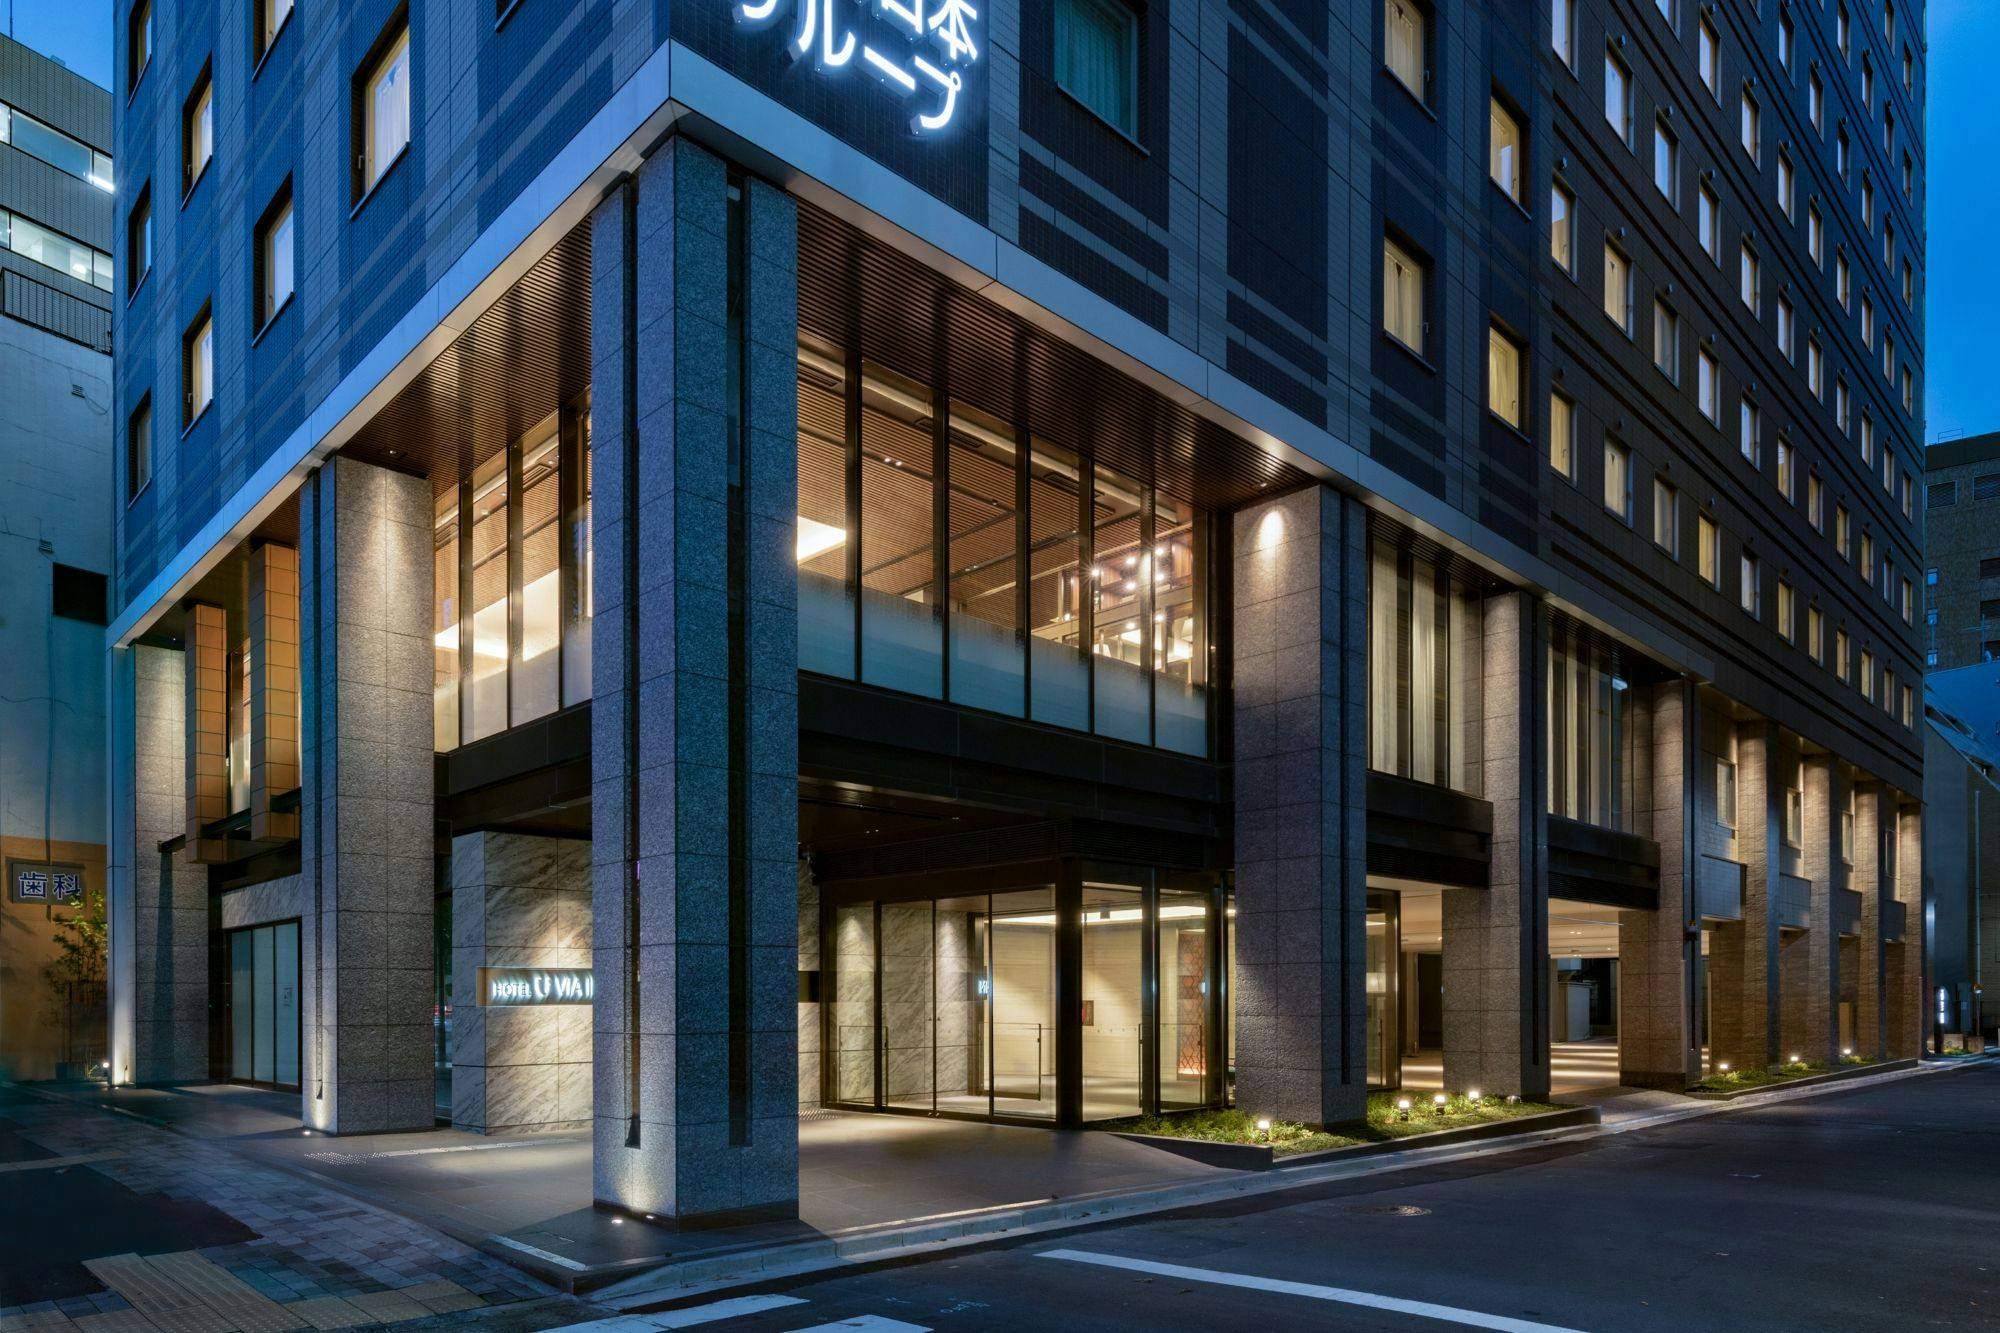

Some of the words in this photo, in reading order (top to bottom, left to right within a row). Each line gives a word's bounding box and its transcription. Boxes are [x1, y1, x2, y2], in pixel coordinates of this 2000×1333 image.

[742, 0, 961, 129] ループ
[19, 871, 81, 900] 歯科
[492, 981, 531, 998] HOTEL
